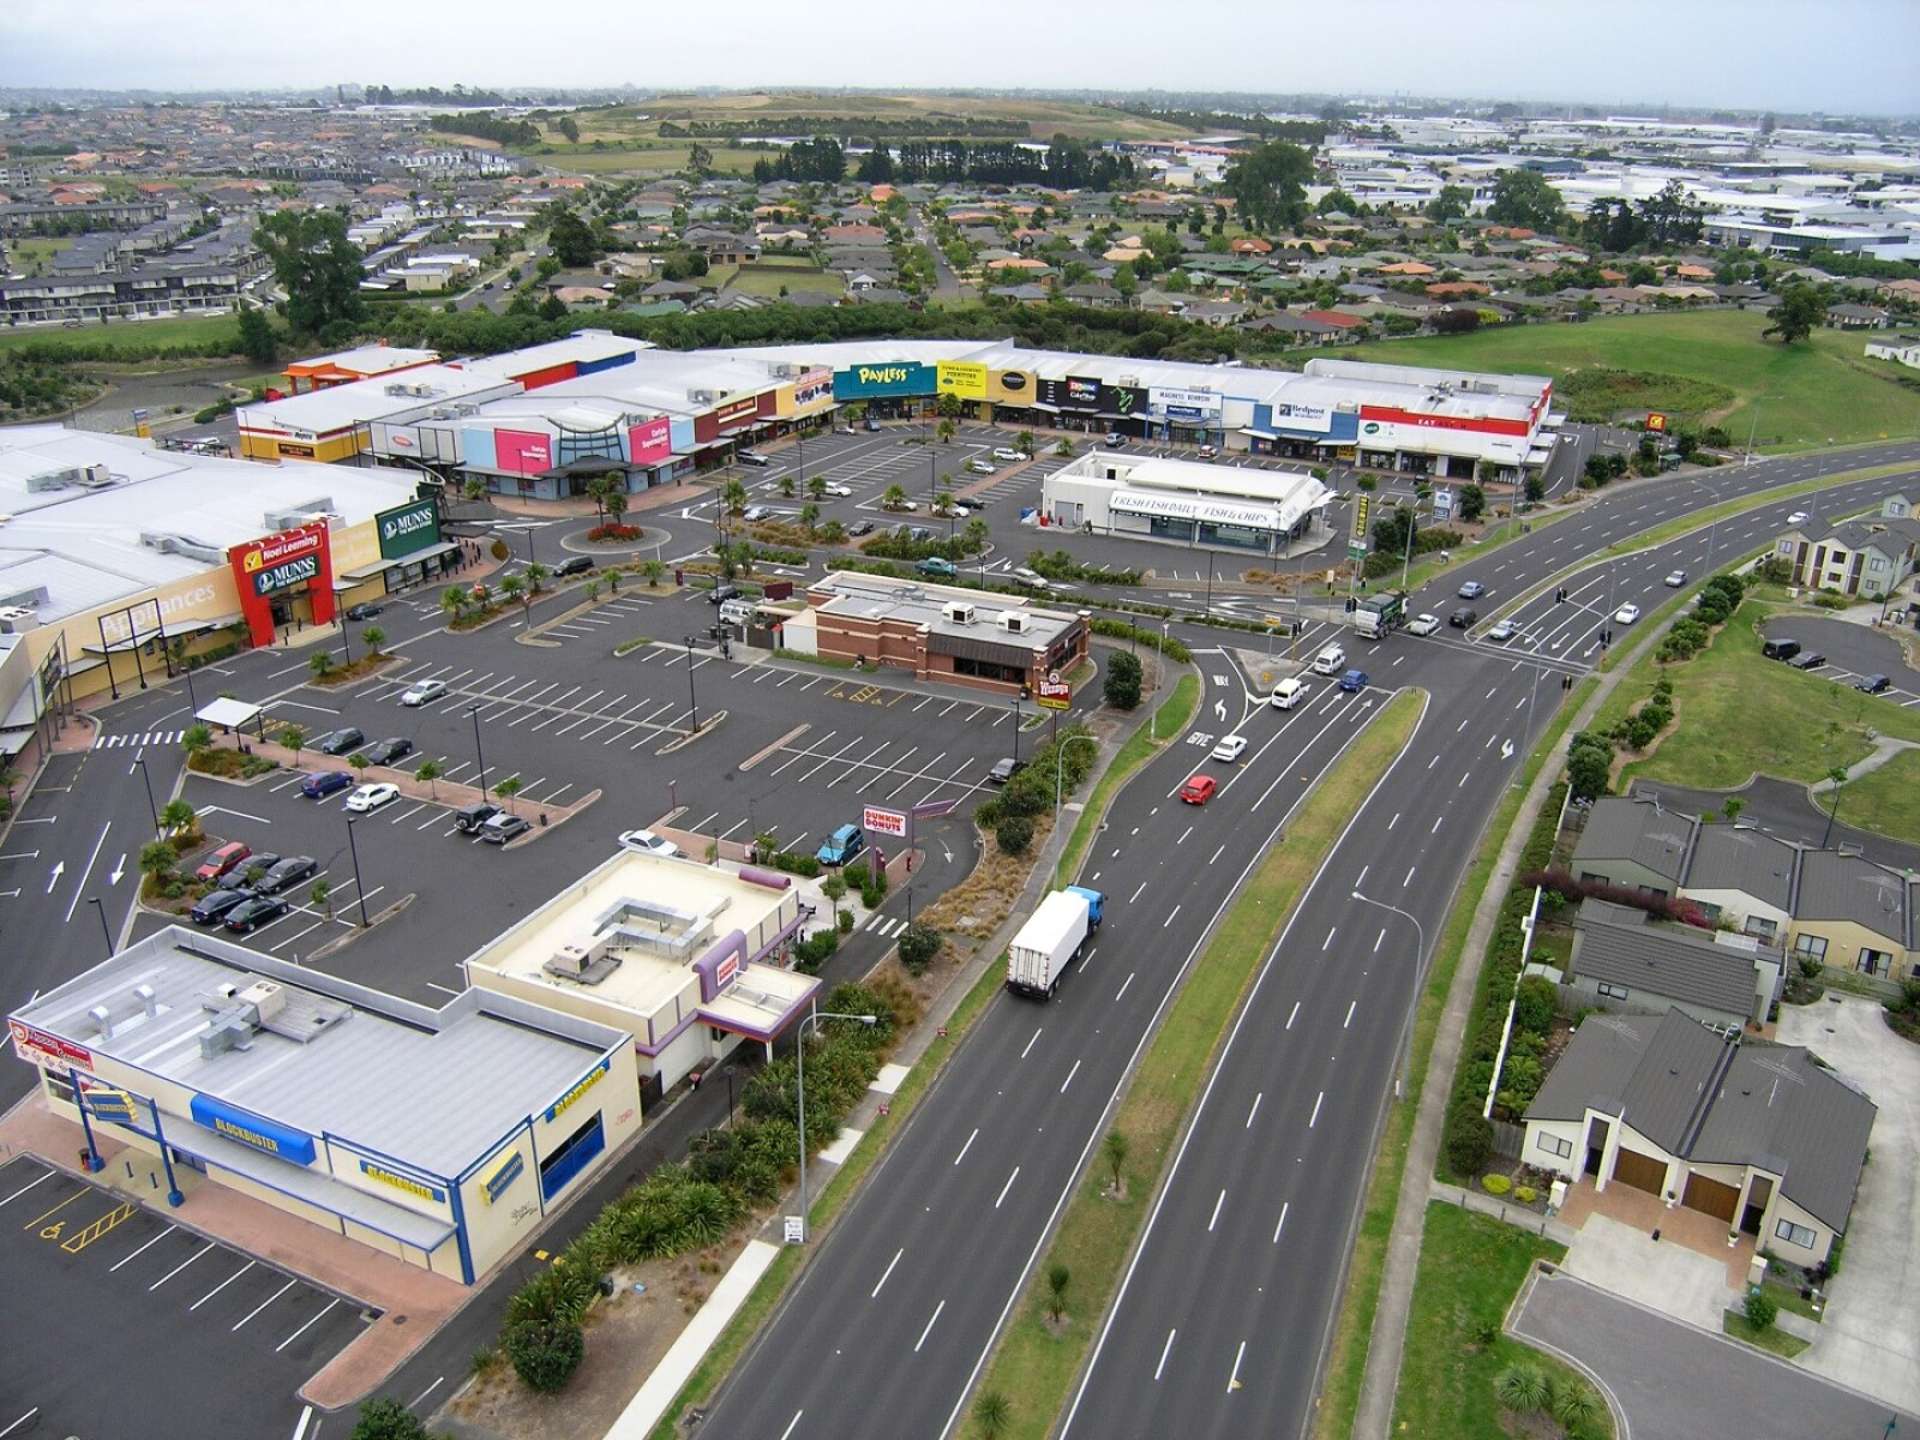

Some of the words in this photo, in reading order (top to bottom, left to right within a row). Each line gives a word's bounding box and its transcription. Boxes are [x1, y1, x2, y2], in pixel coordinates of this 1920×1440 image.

[859, 367, 907, 384] PAYLESS
[1292, 404, 1324, 415] Bedpost
[397, 507, 433, 529] MUNNS
[1114, 496, 1145, 507] FRESH
[1146, 499, 1169, 511] FISH
[1169, 503, 1198, 515] DAILY
[1204, 507, 1229, 517] FISH
[1236, 511, 1269, 522] CHIPS
[263, 544, 282, 561] Noel
[283, 534, 318, 554] Leeming
[274, 556, 316, 579] MUNNS
[865, 811, 904, 823] DUNKIN'
[865, 819, 901, 831] DONUTS
[215, 1117, 279, 1152] BLOCKBUSTER
[367, 1165, 434, 1201] BLOCKBUSTER
